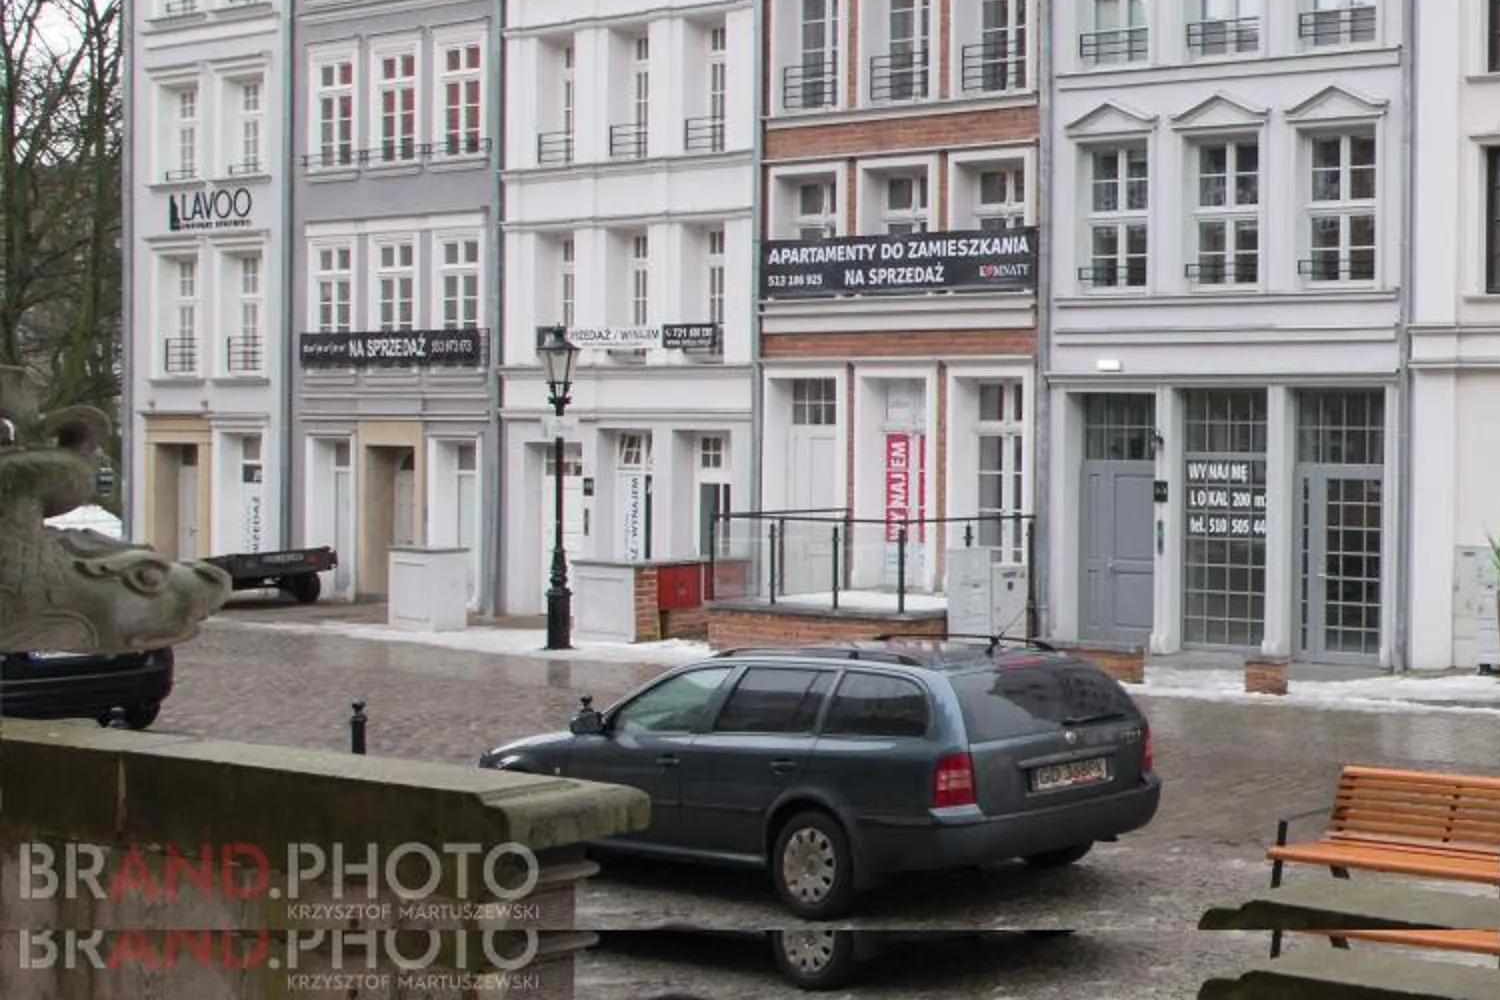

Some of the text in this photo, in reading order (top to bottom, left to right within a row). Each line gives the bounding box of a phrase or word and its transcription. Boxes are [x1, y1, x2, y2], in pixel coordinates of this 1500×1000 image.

[768, 236, 1029, 265] APARTAMENTY DO ZAMIESZKANIA
[844, 269, 865, 285] NA
[868, 261, 945, 285] SPRZEDAŻ
[350, 339, 365, 357] NA
[367, 334, 427, 357] SPRZEDAŻ
